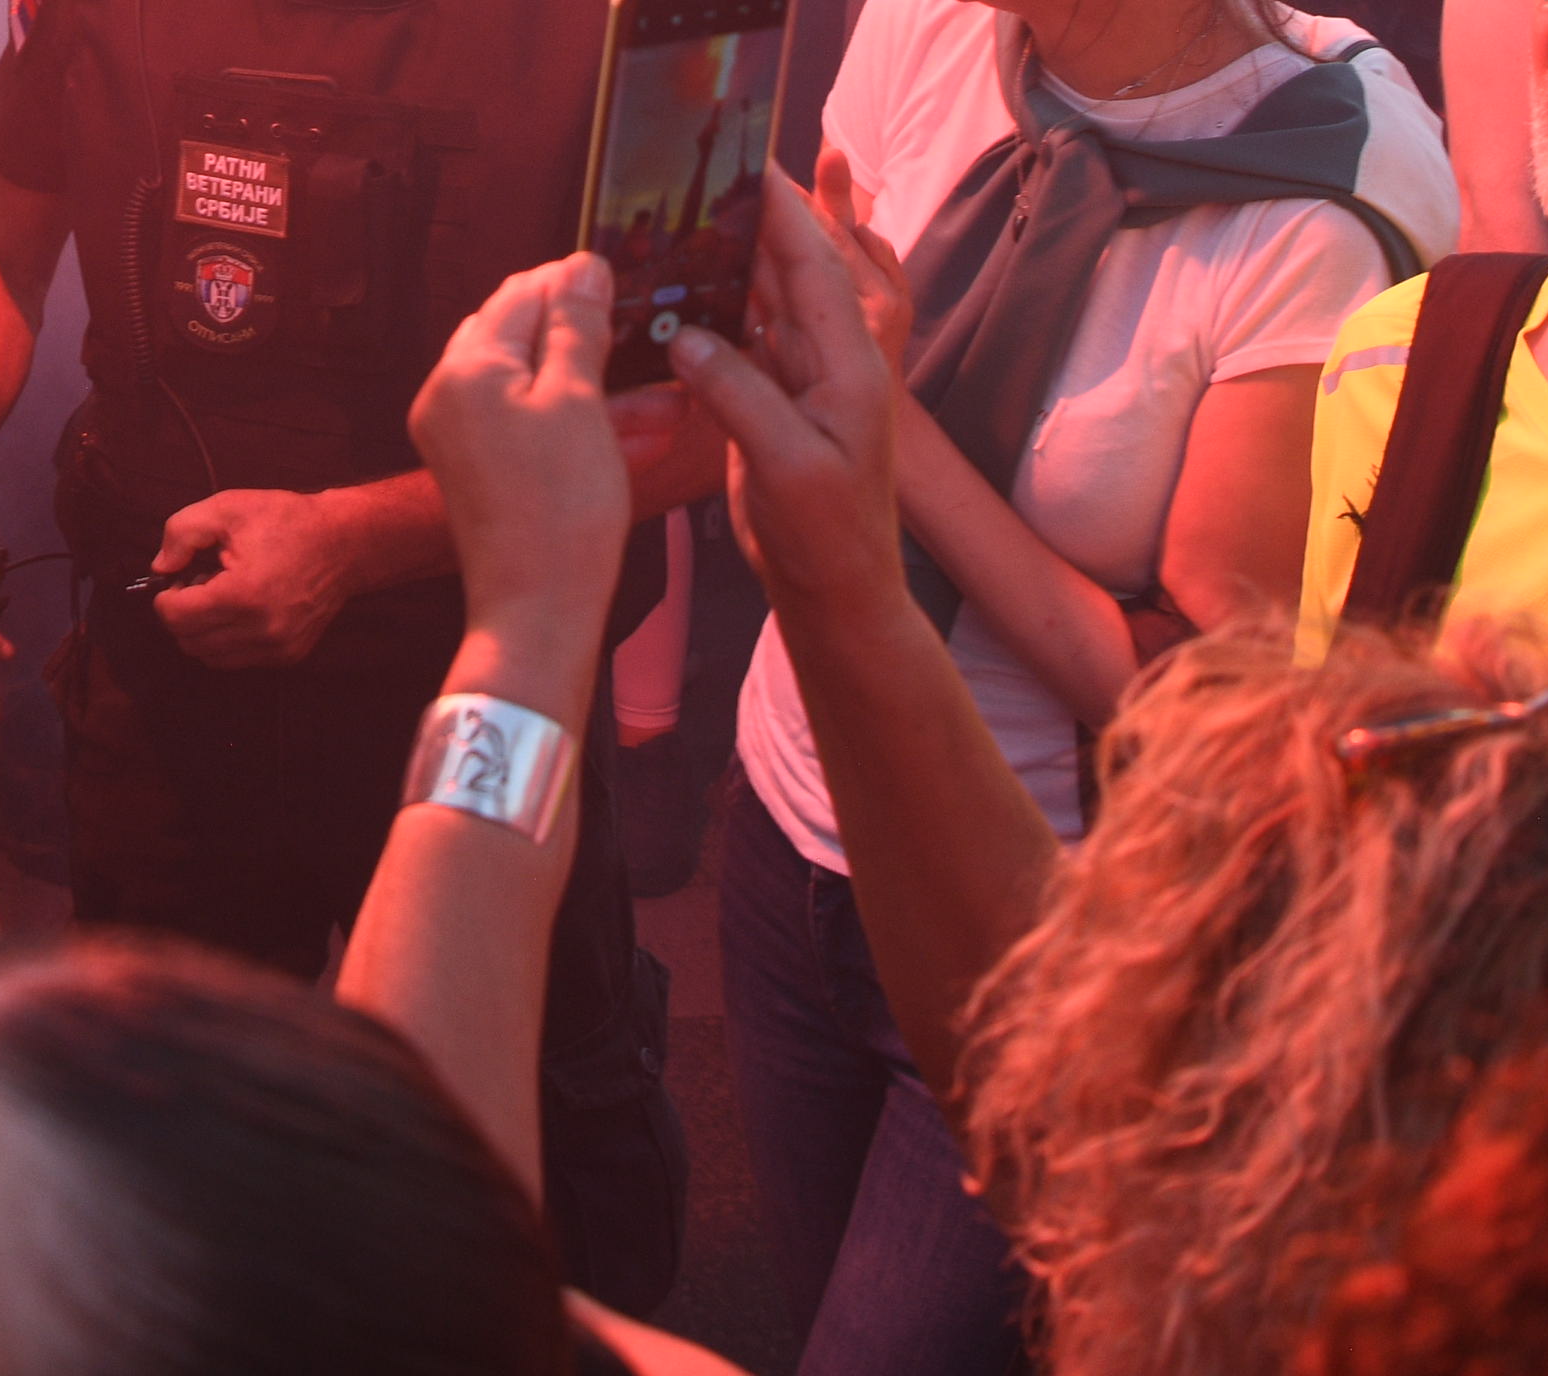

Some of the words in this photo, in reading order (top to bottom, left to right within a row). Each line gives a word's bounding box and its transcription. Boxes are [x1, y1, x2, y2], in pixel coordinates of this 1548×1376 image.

[203, 152, 267, 183] РАТНИ
[185, 171, 283, 207] ВЕТЕРАНИ
[194, 196, 269, 226] СРБИЈЕ
